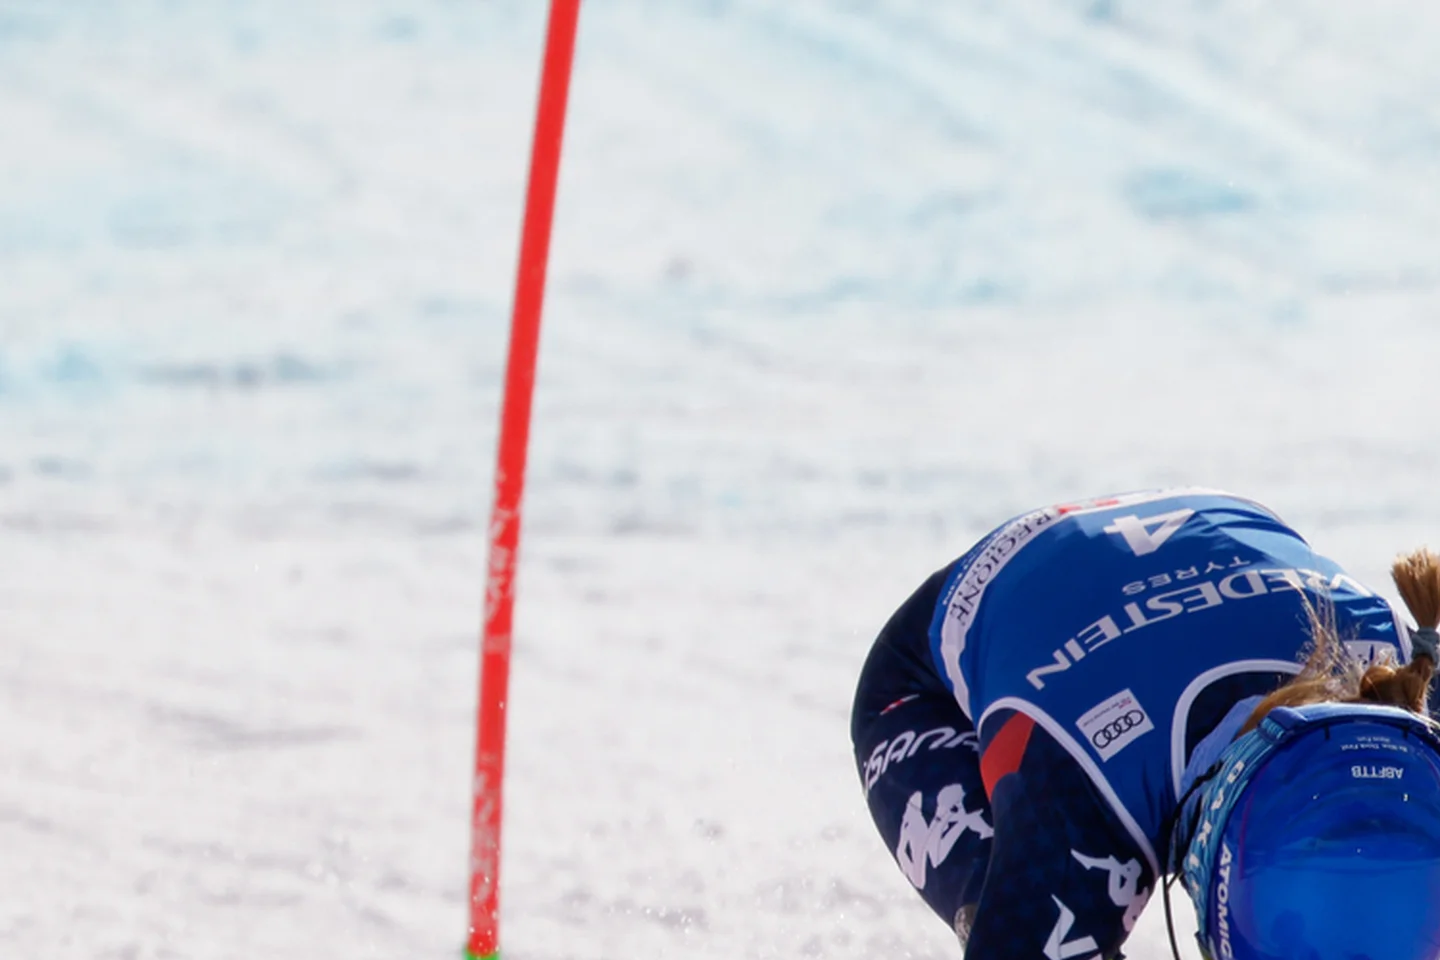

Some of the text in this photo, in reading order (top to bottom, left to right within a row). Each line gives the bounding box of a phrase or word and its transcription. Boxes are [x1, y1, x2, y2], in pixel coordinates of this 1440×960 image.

[1103, 508, 1196, 557] 4
[1122, 555, 1250, 595] TYRES
[1351, 765, 1404, 779] ABFTTB
[1217, 841, 1233, 959] ATOMIC
